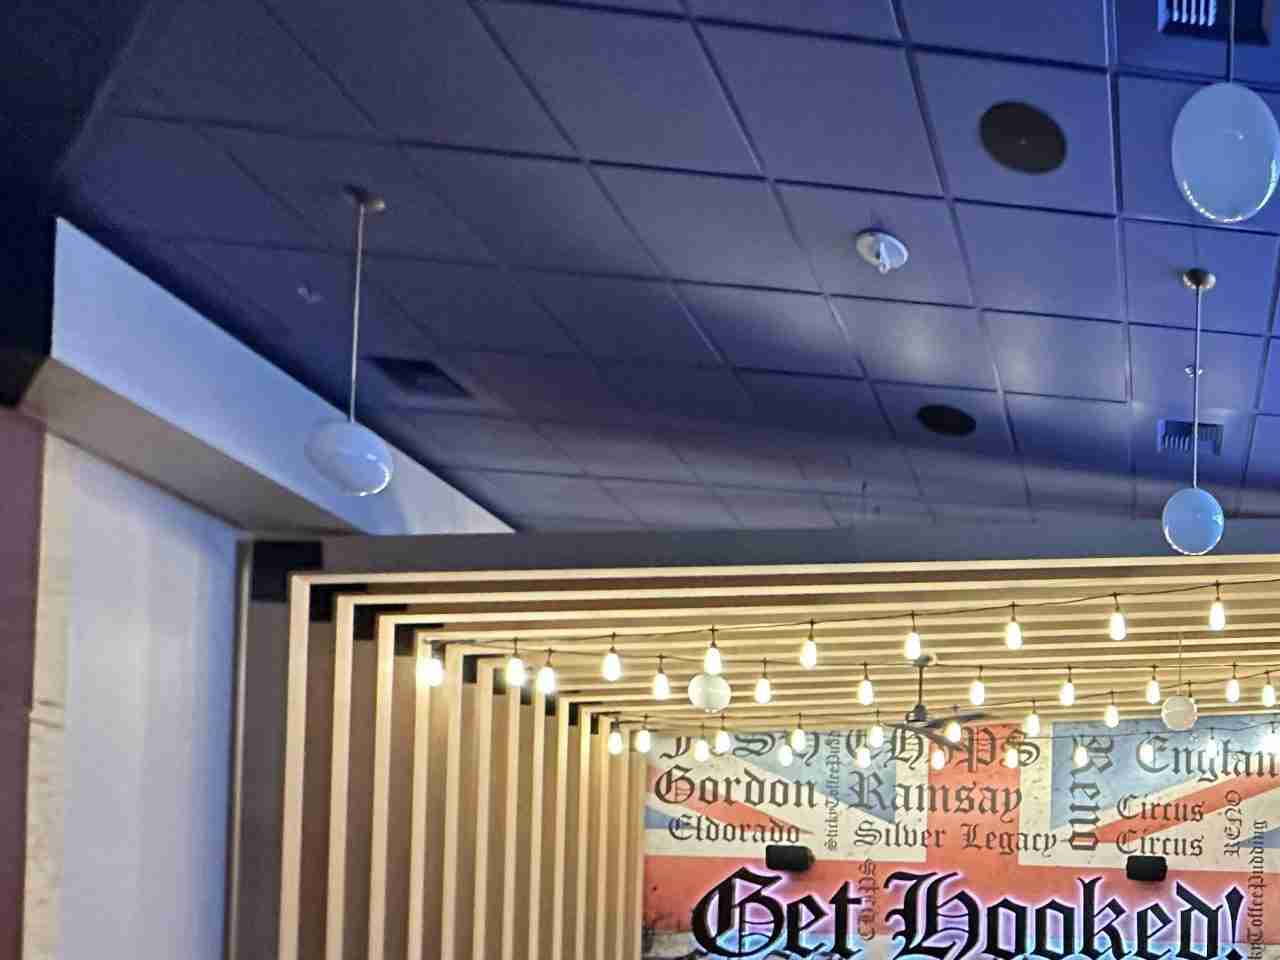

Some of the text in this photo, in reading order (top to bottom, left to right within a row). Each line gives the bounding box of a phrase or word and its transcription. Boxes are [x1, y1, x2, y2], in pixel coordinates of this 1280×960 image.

[654, 764, 1023, 823] Gordon Ramsay
[1117, 793, 1205, 822] Circus
[668, 815, 800, 845] Eldorado
[853, 820, 1058, 858] Silver Legacy
[1116, 829, 1204, 857] Circus
[691, 866, 864, 960] Get
